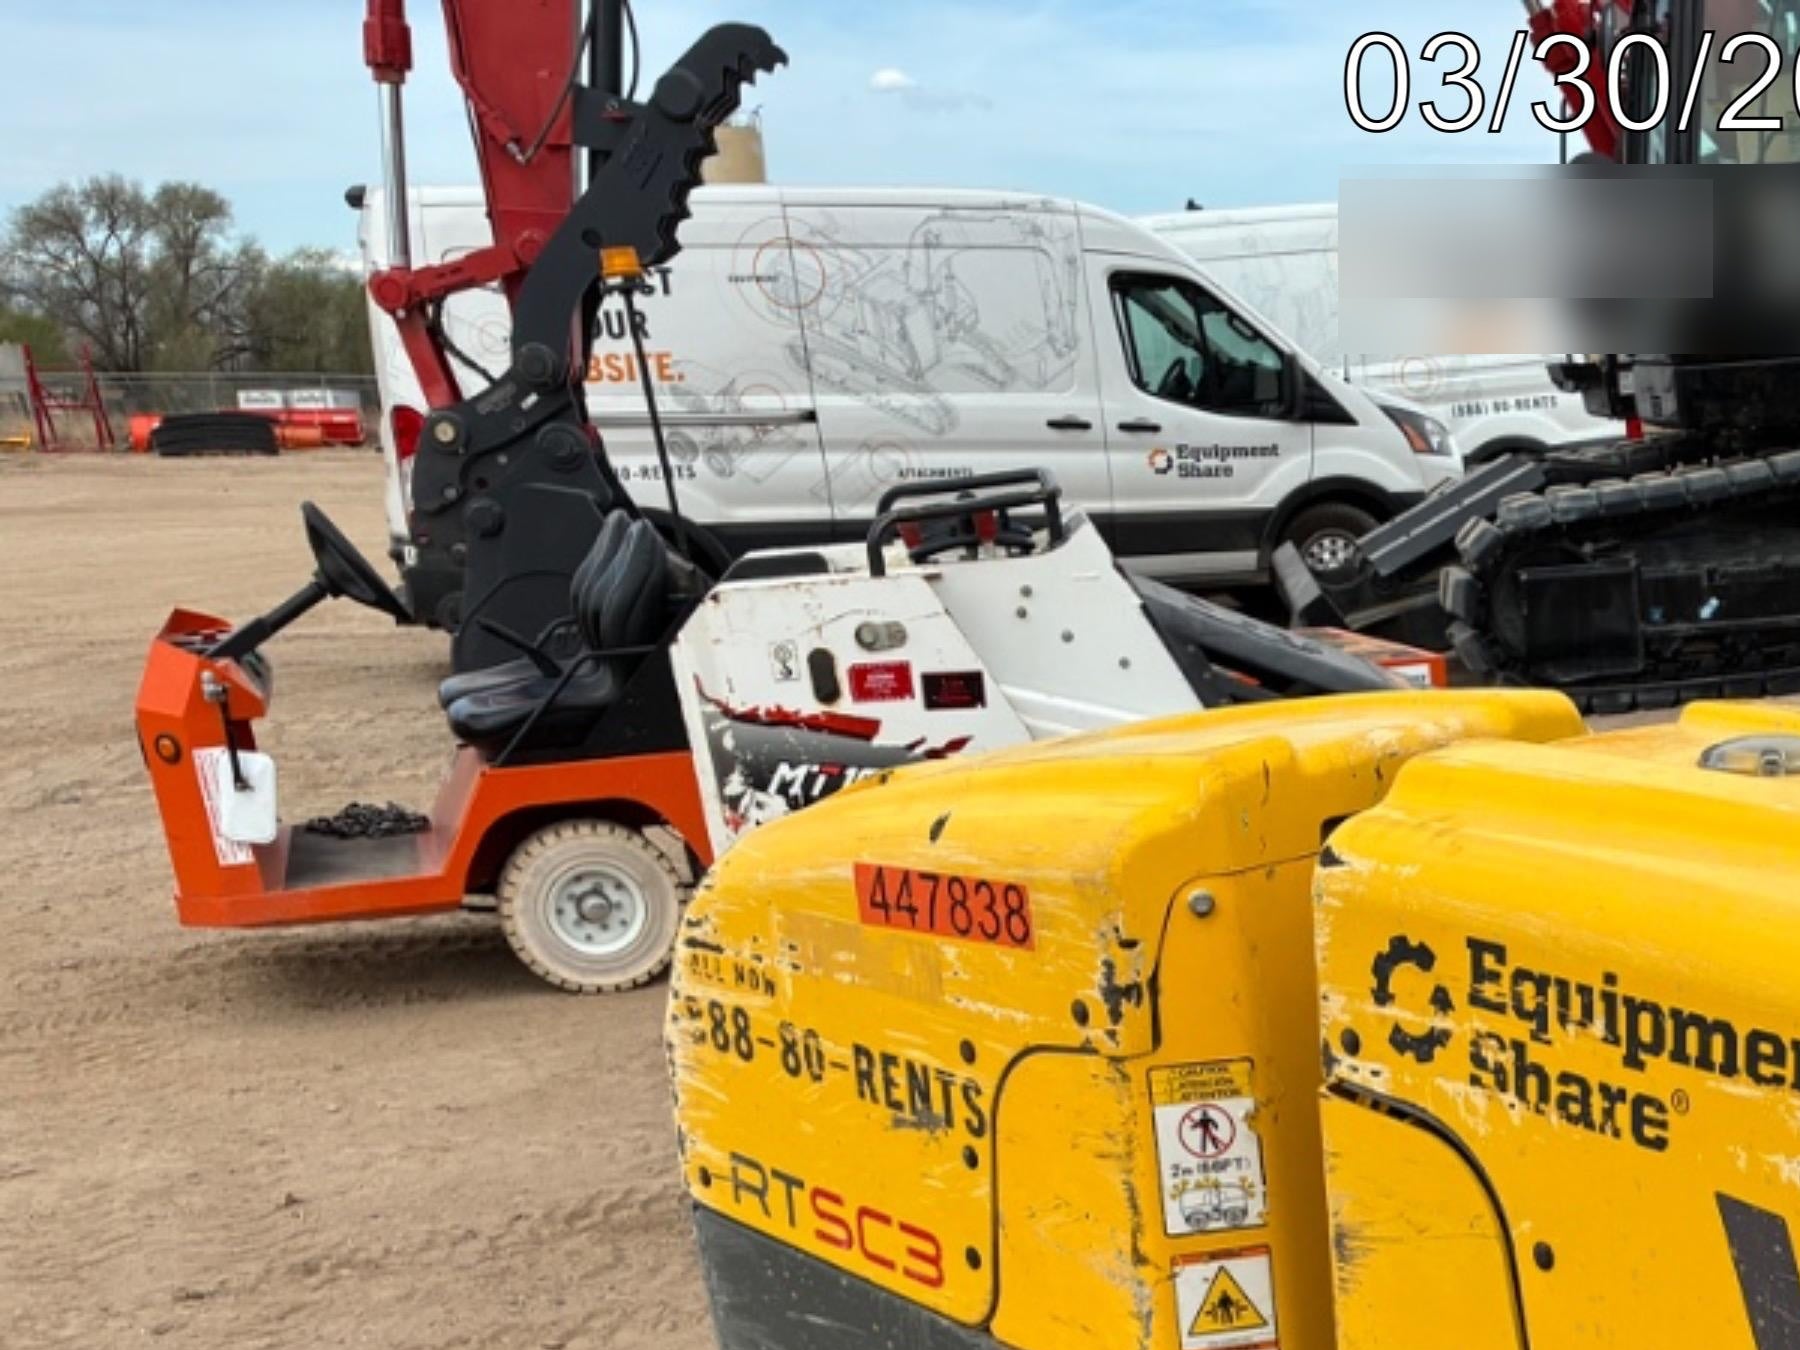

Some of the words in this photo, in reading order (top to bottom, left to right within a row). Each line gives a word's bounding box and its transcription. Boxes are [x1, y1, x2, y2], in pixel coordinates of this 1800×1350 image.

[1175, 443, 1279, 462] Equipment
[1177, 463, 1234, 477] Share
[869, 866, 1030, 945] 447838
